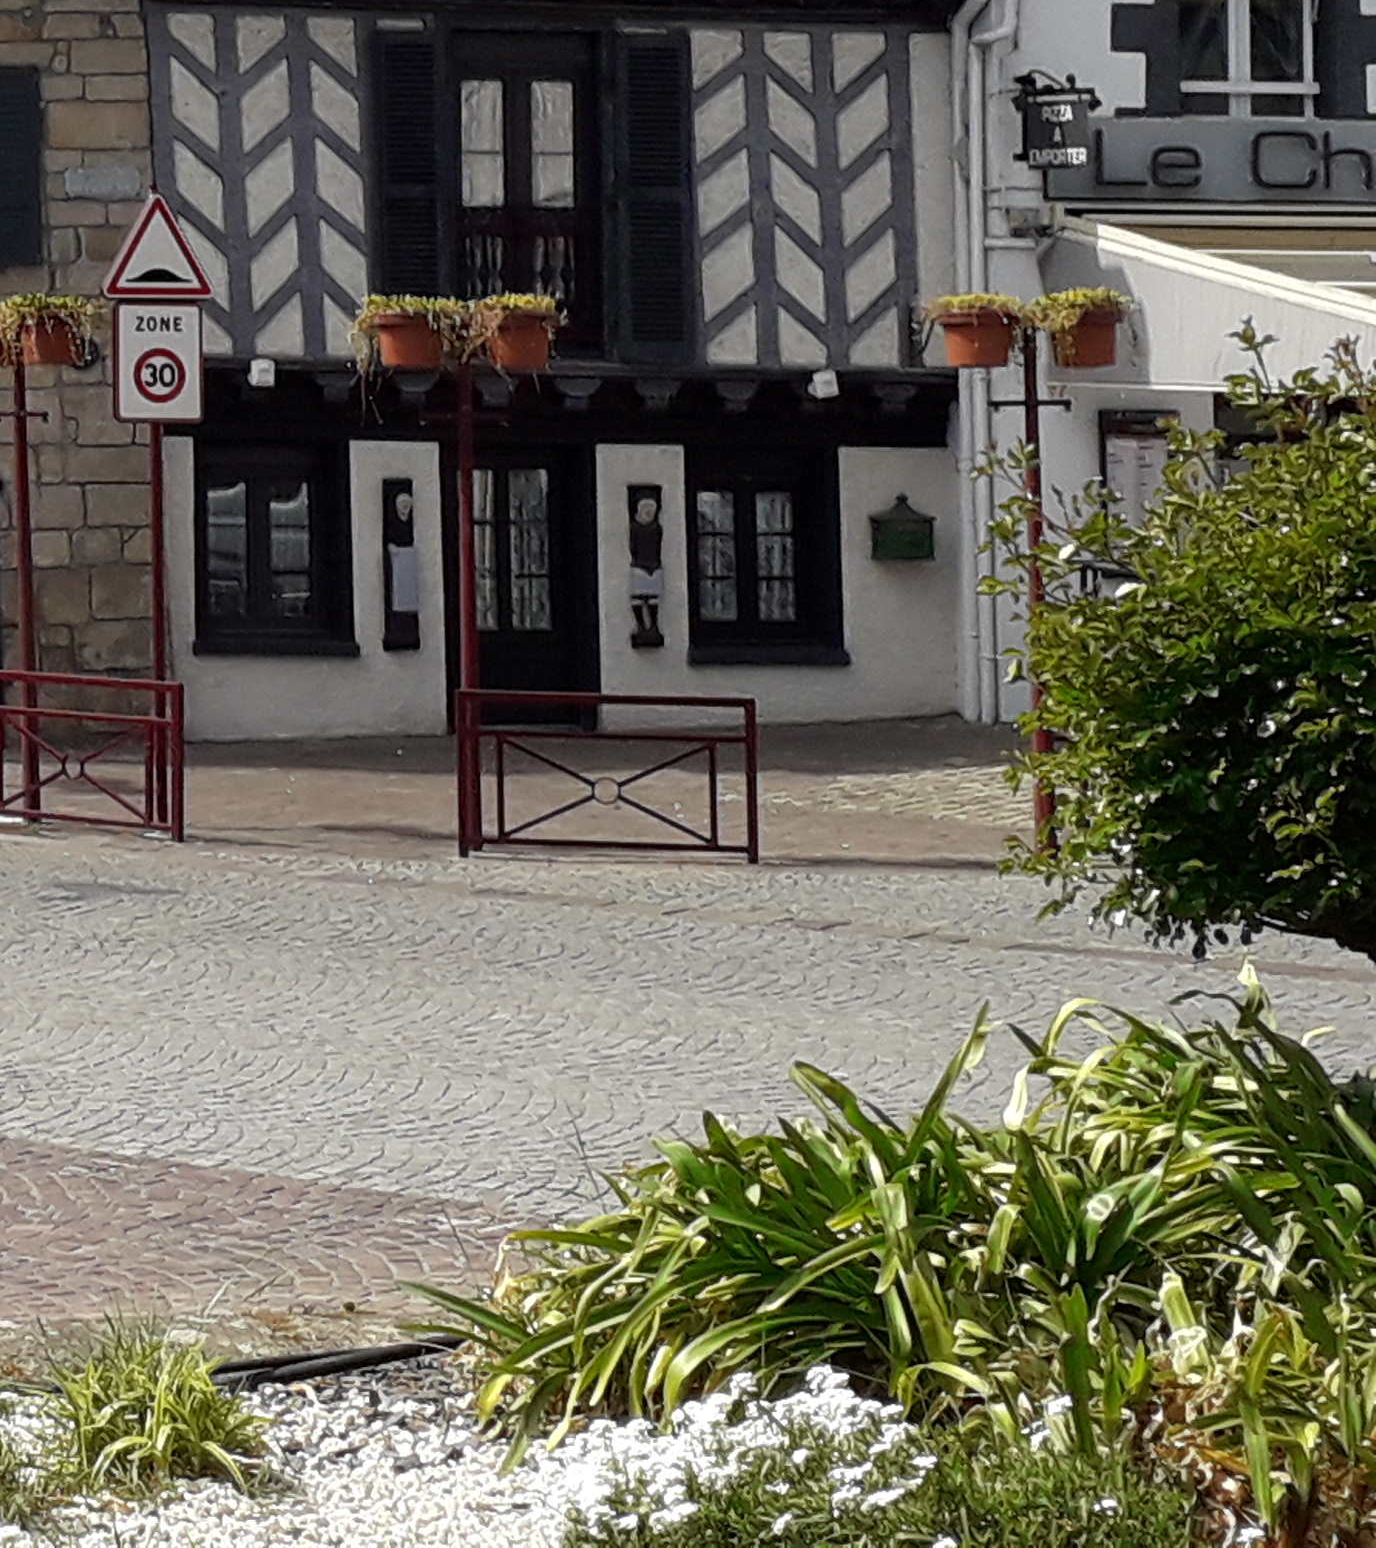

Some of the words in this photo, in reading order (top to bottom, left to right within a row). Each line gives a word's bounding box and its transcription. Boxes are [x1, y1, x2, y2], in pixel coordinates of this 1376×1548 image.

[1093, 130, 1203, 190] Le
[1251, 130, 1373, 190] Ch
[135, 316, 183, 332] ZONE
[145, 363, 177, 388] 30
